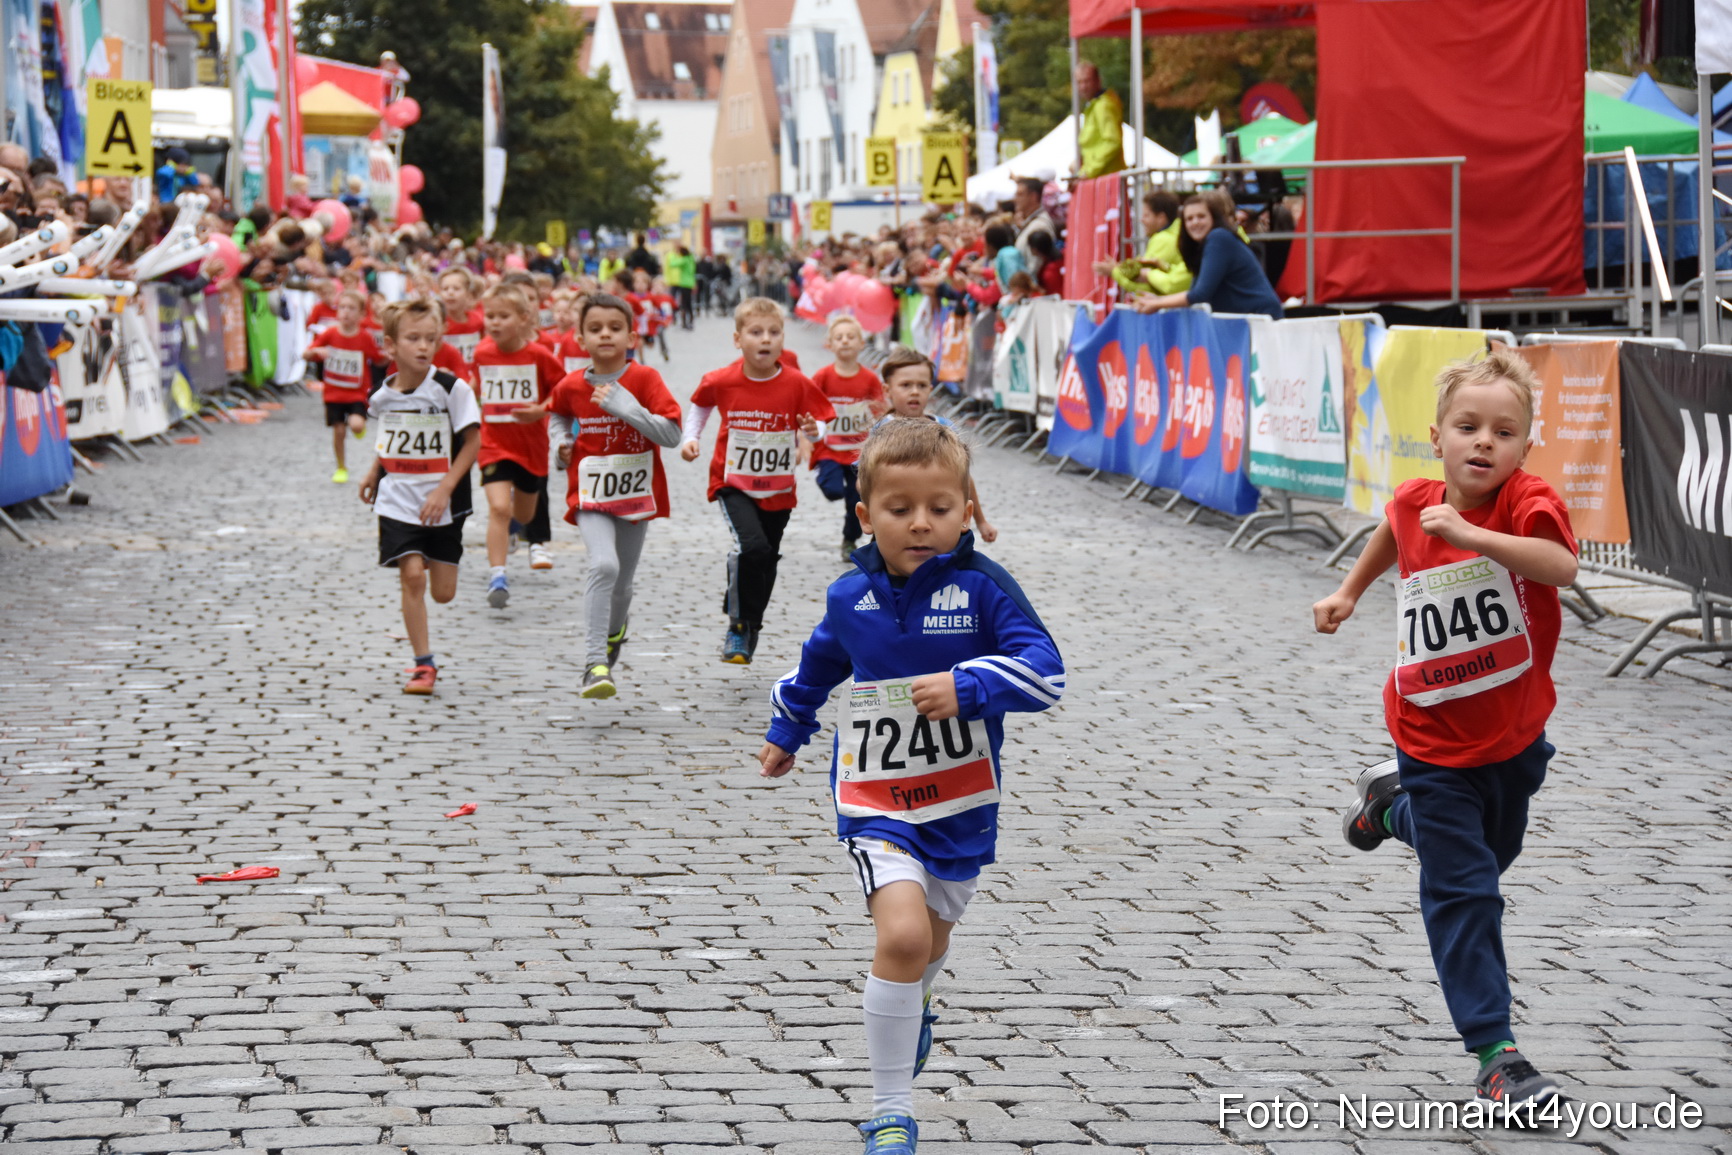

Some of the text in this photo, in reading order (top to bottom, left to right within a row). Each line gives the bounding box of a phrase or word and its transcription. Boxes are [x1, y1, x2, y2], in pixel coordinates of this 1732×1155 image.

[95, 82, 146, 101] Block
[102, 110, 137, 154] A
[873, 152, 889, 175] B
[932, 154, 957, 187] A
[486, 380, 531, 399] 7178
[385, 430, 442, 454] 7244
[735, 447, 790, 472] 7094
[588, 469, 647, 498] 7082
[1677, 408, 1732, 538] M
[1427, 561, 1495, 589] BOCK
[854, 602, 880, 611] adidas
[923, 615, 973, 628] MEIER
[1404, 588, 1509, 656] 7046
[1513, 625, 1521, 634] K
[1421, 651, 1497, 686] Leopold
[852, 714, 974, 773] 7240
[977, 749, 985, 758] K
[844, 771, 850, 780] 2
[889, 783, 939, 810] Fynn
